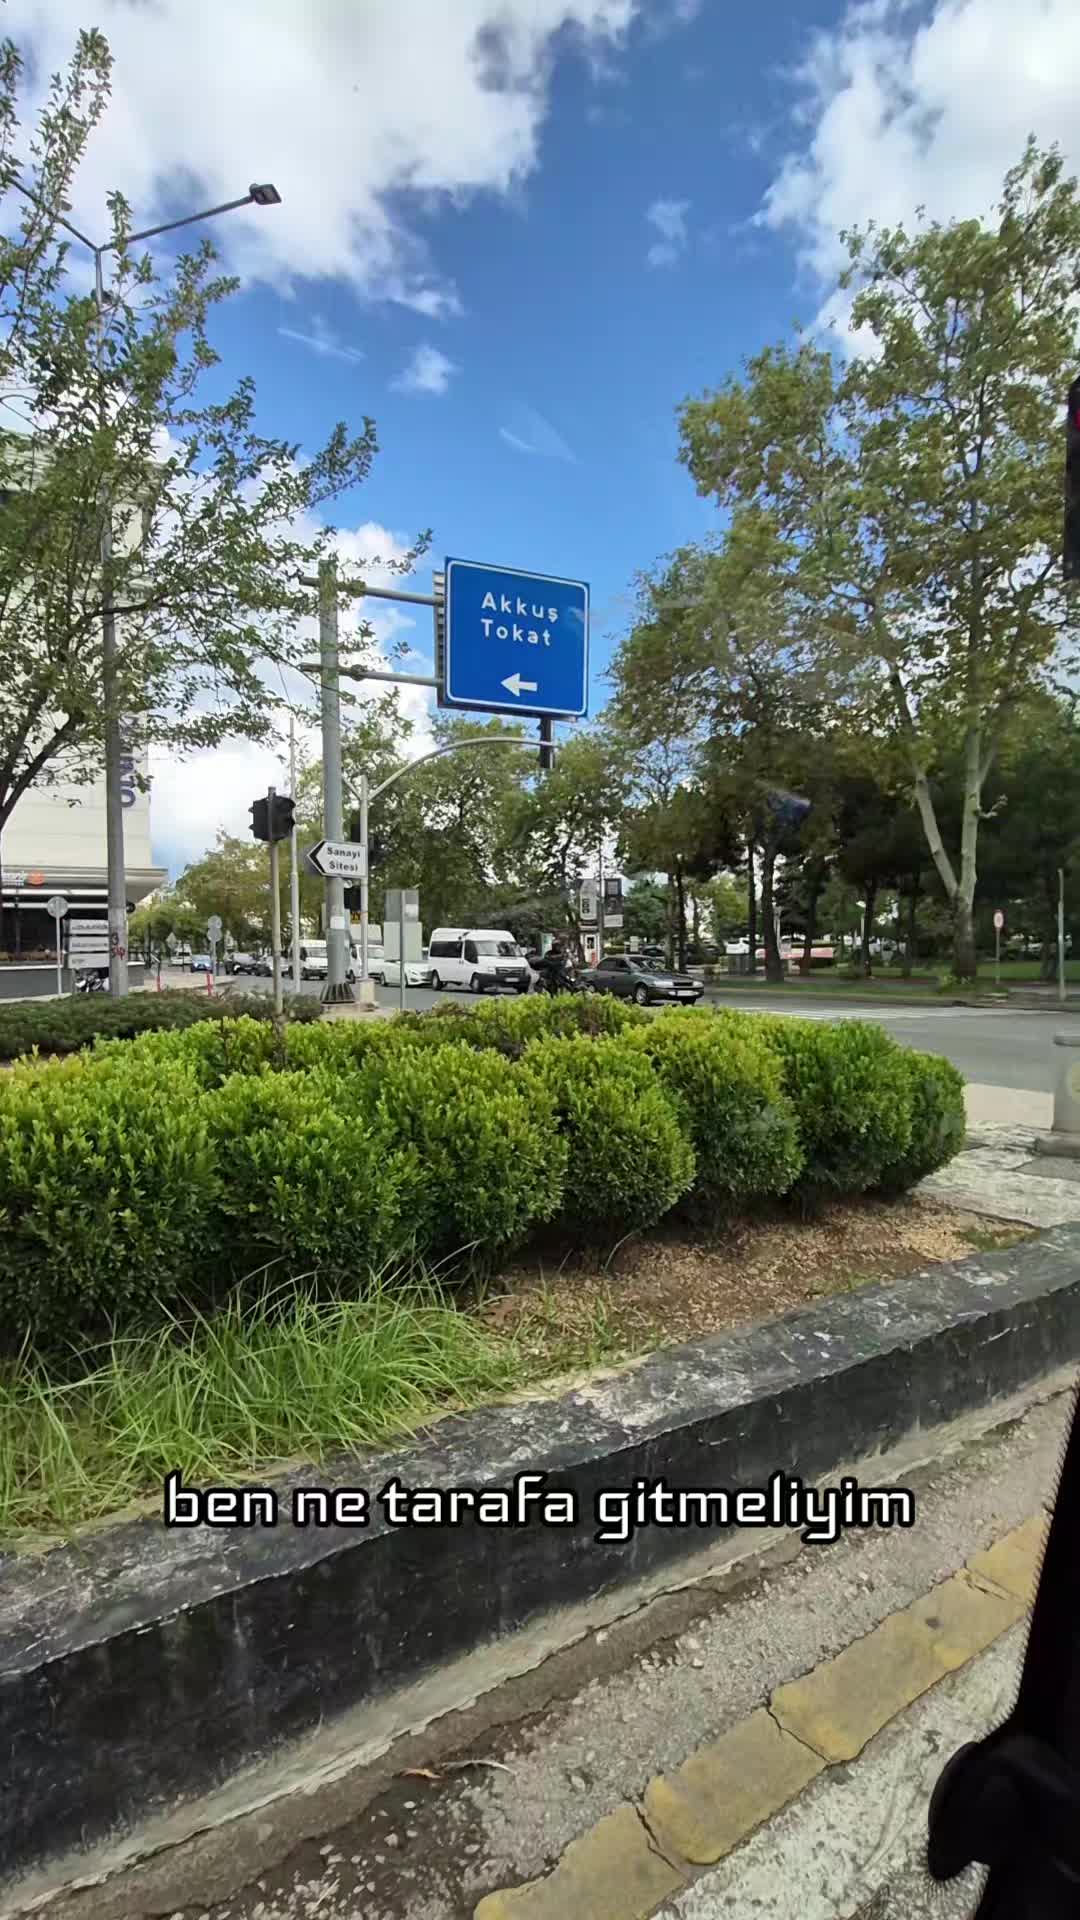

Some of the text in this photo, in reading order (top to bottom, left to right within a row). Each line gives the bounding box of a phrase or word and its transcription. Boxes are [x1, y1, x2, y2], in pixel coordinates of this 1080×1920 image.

[480, 591, 559, 623] Akkuş
[480, 618, 551, 647] Tokat
[327, 846, 361, 860] Sanayi
[328, 860, 359, 873] Sitesi
